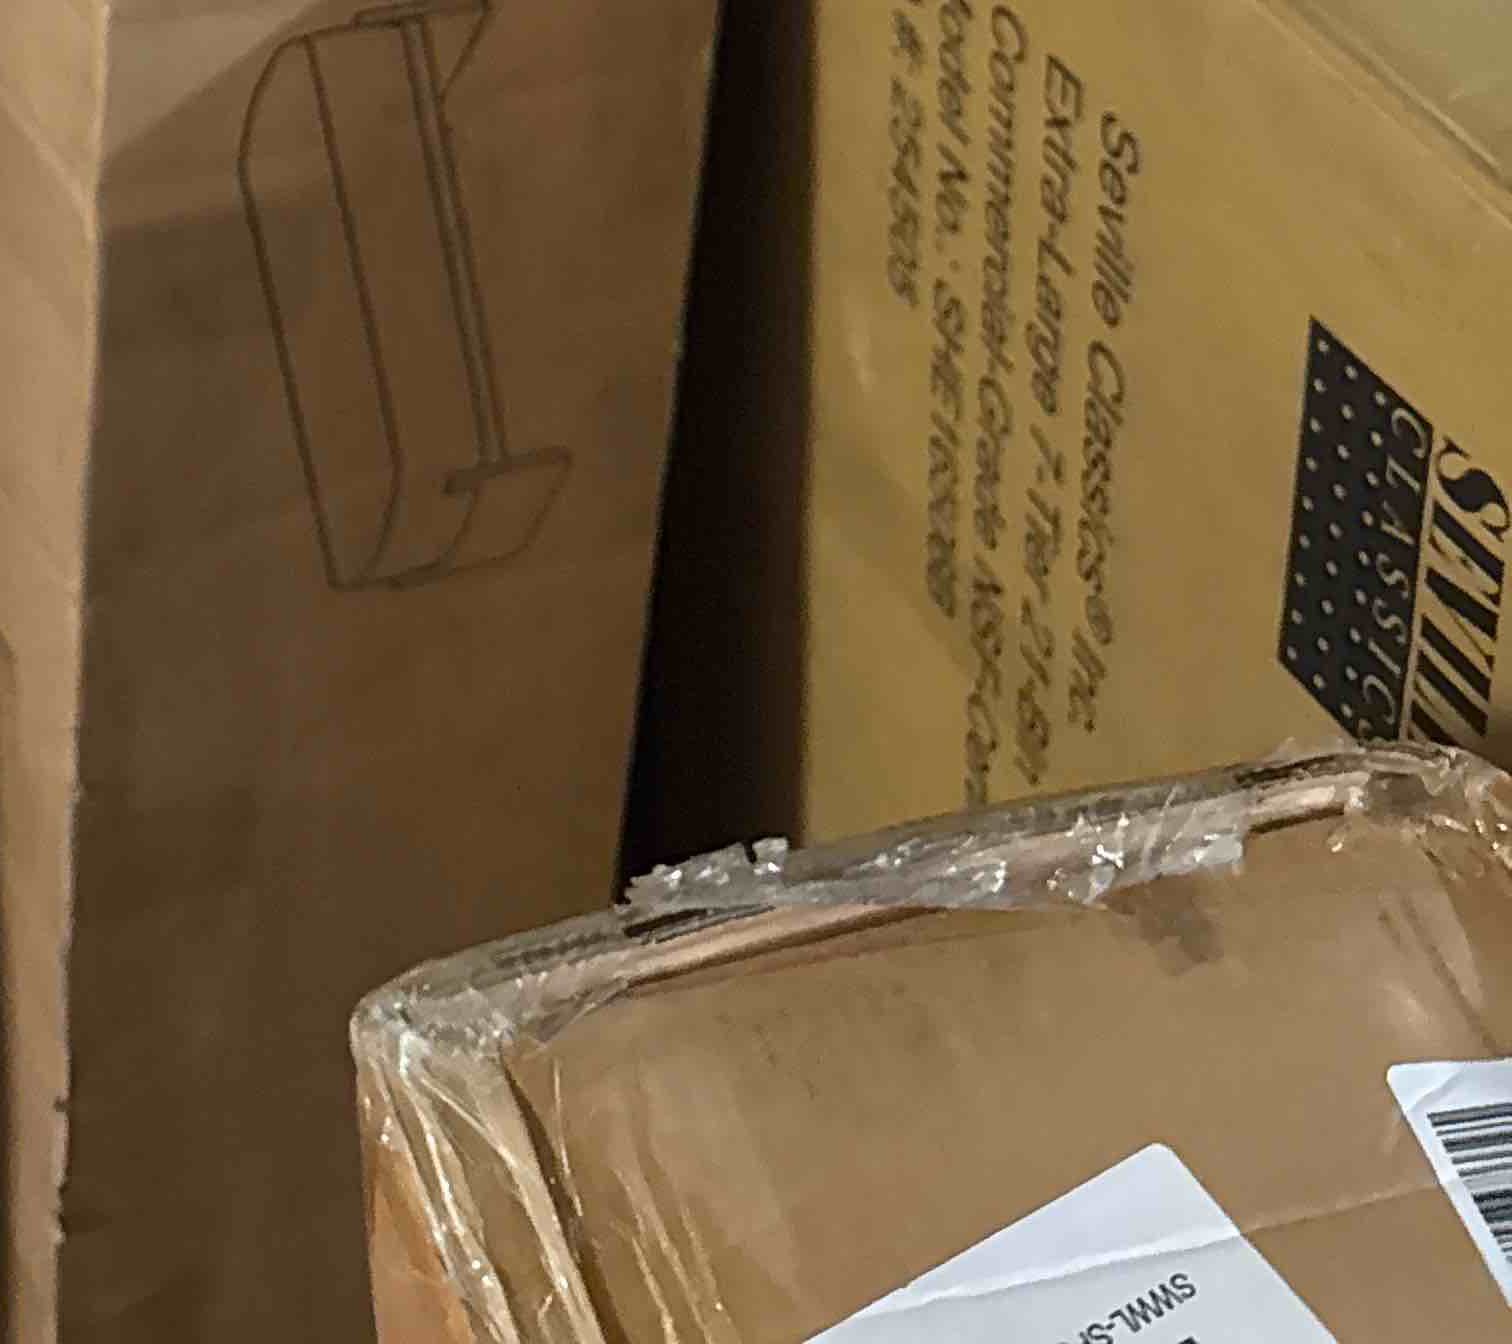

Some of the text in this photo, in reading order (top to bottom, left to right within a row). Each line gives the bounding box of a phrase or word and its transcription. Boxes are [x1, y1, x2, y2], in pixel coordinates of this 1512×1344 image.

[1026, 53, 1086, 416] Extra-Large
[1093, 110, 1141, 329] Seville
[1356, 408, 1429, 740] CLASSIC
[1058, 1272, 1196, 1344] SWWL-S
